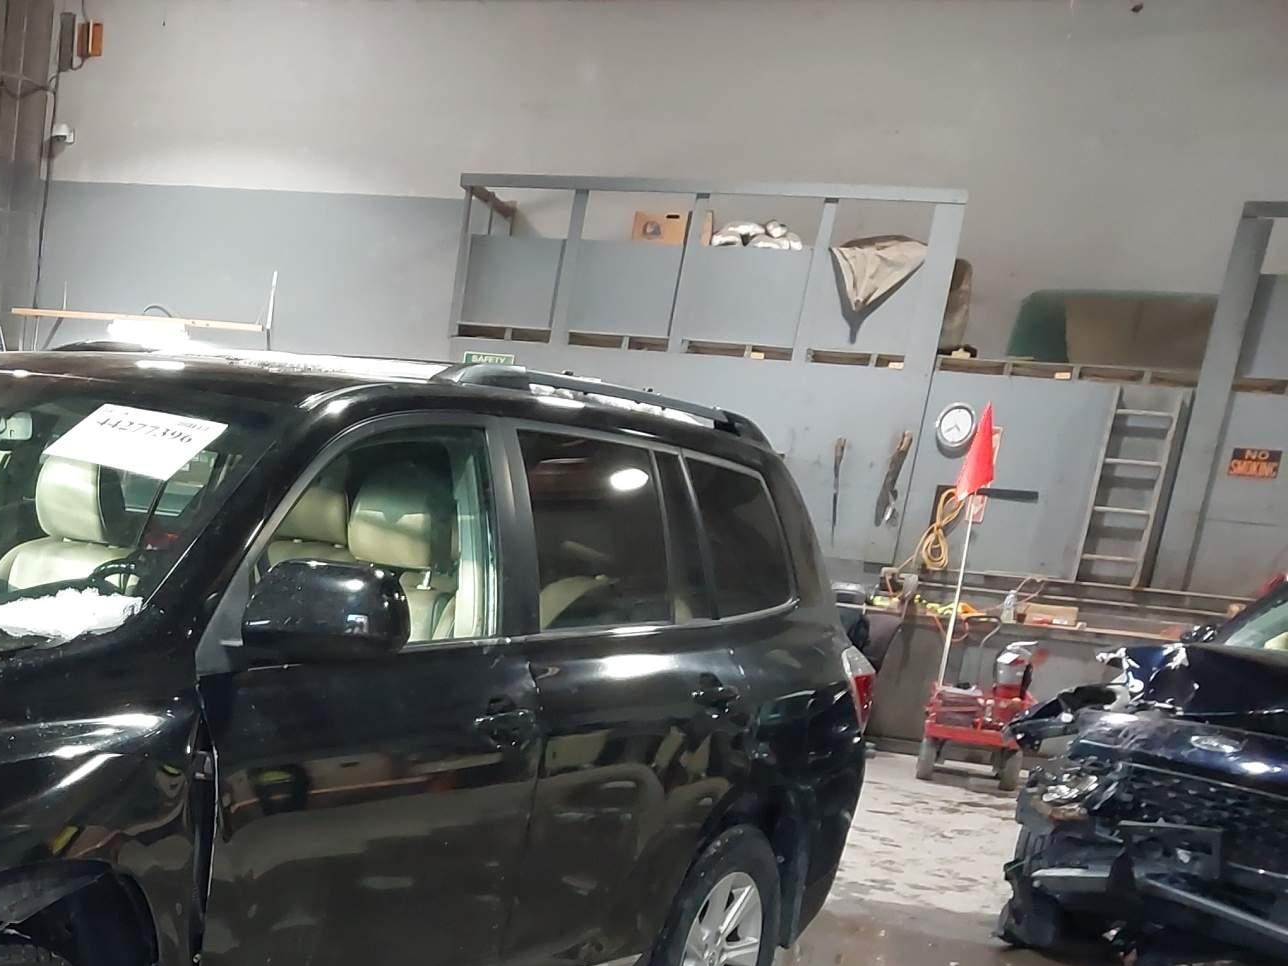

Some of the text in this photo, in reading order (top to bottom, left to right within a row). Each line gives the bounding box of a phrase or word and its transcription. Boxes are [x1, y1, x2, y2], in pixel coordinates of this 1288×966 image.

[472, 354, 506, 364] SAFETY
[97, 418, 192, 443] 44277396
[1245, 450, 1270, 460] NO
[1230, 459, 1279, 477] SMOKING
